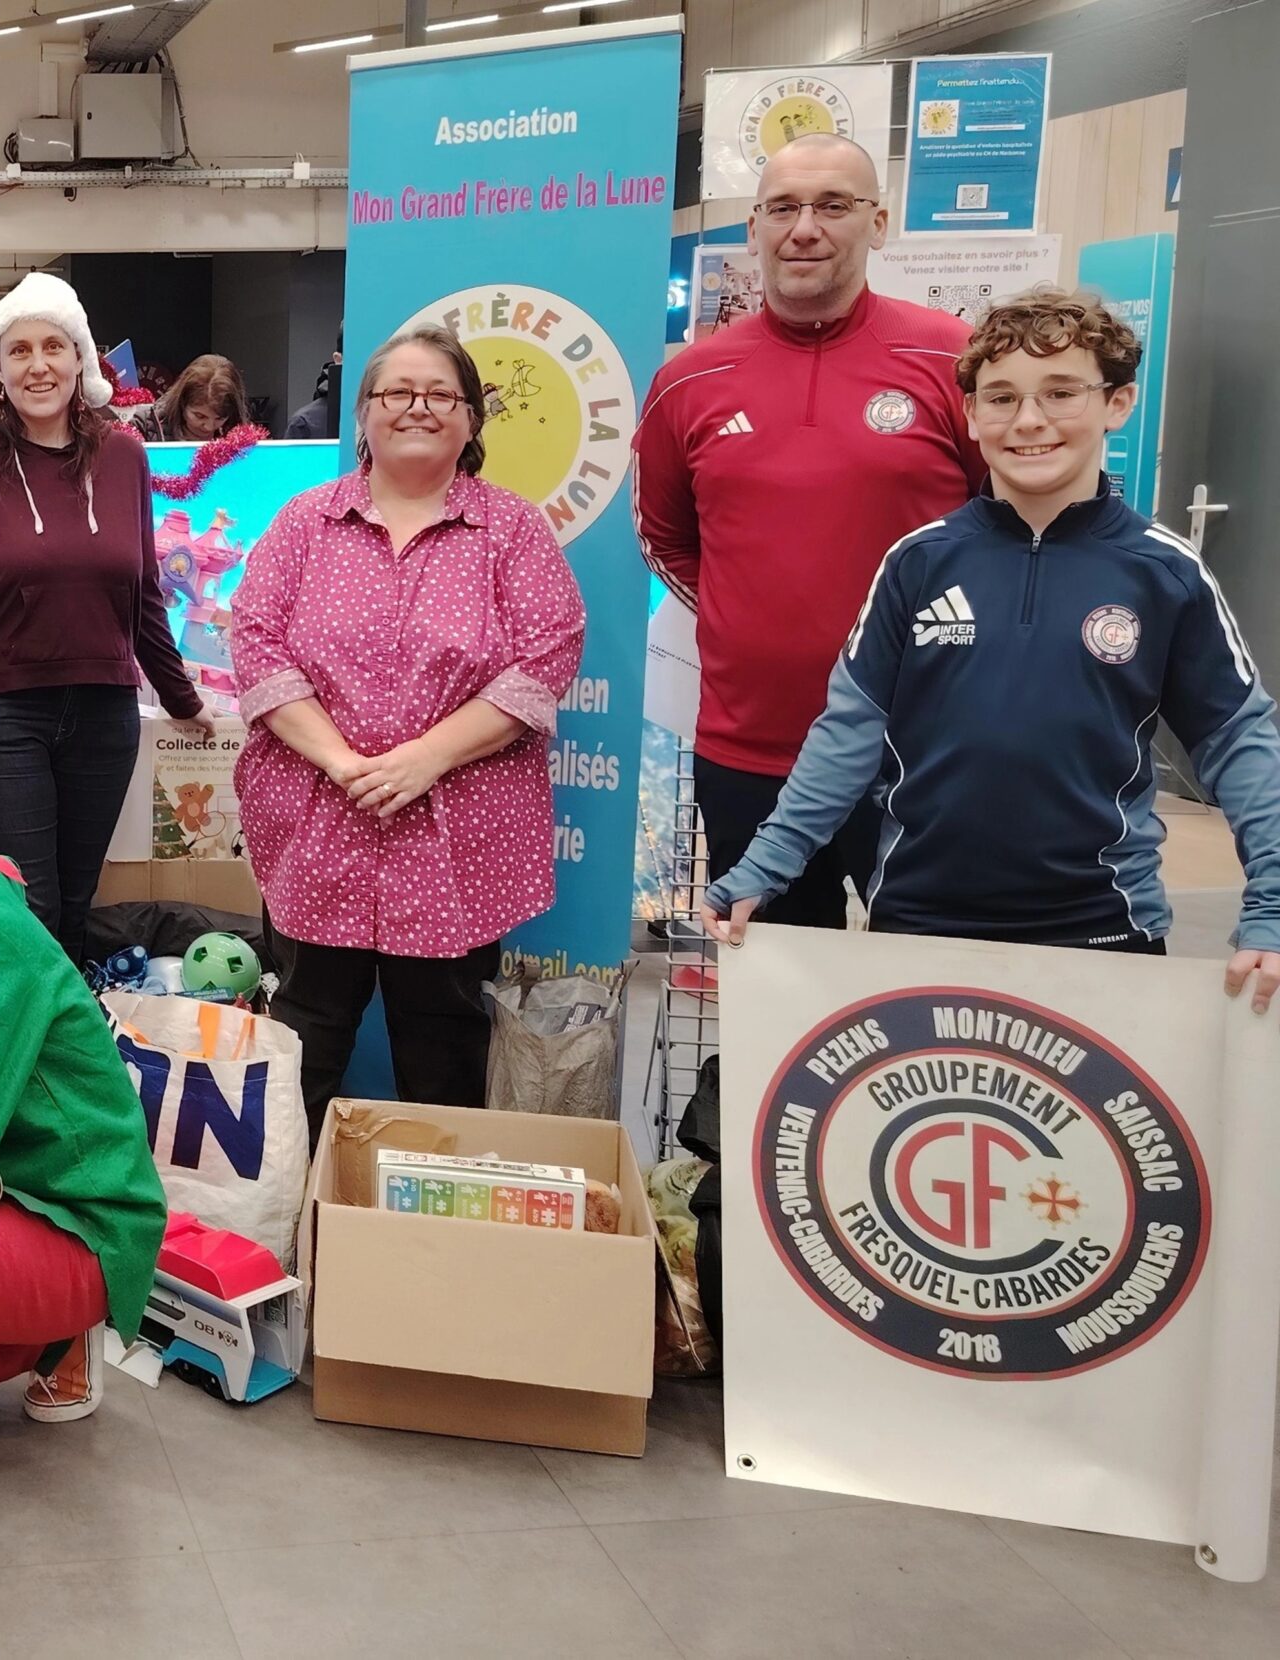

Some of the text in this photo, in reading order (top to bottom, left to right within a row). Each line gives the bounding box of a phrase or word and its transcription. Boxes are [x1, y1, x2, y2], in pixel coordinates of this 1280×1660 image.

[777, 79, 825, 98] FRÈRE
[435, 106, 577, 145] Association
[353, 169, 666, 224] Mon Grand Frère de la Lune
[882, 253, 909, 262] Vous
[911, 251, 961, 261] souhaitez
[965, 252, 977, 260] en
[980, 250, 1014, 259] savoir
[1015, 249, 1039, 260] plus
[903, 265, 935, 275] Venez
[938, 264, 970, 274] visiter
[972, 263, 1000, 273] notre
[1002, 263, 1022, 272] site
[442, 292, 563, 341] FRÈRE
[562, 333, 609, 385] DE
[588, 398, 621, 442] LA
[937, 634, 976, 645] SPORT
[940, 624, 976, 635] INTER
[156, 738, 240, 750] Collecte de
[805, 1018, 890, 1086] PEZENS
[932, 1006, 1087, 1076] MONTOLIEU
[867, 1059, 1082, 1135] GROUPEMENT
[1103, 1090, 1184, 1192] SAISSAC
[775, 1102, 885, 1322] VENTENAC-CABARDES
[839, 1200, 1111, 1309] FRESQUEL-CABARDES
[1055, 1221, 1185, 1355] MOUSSOULENS
[194, 1319, 215, 1336] 08
[936, 1327, 1002, 1363] 2018
